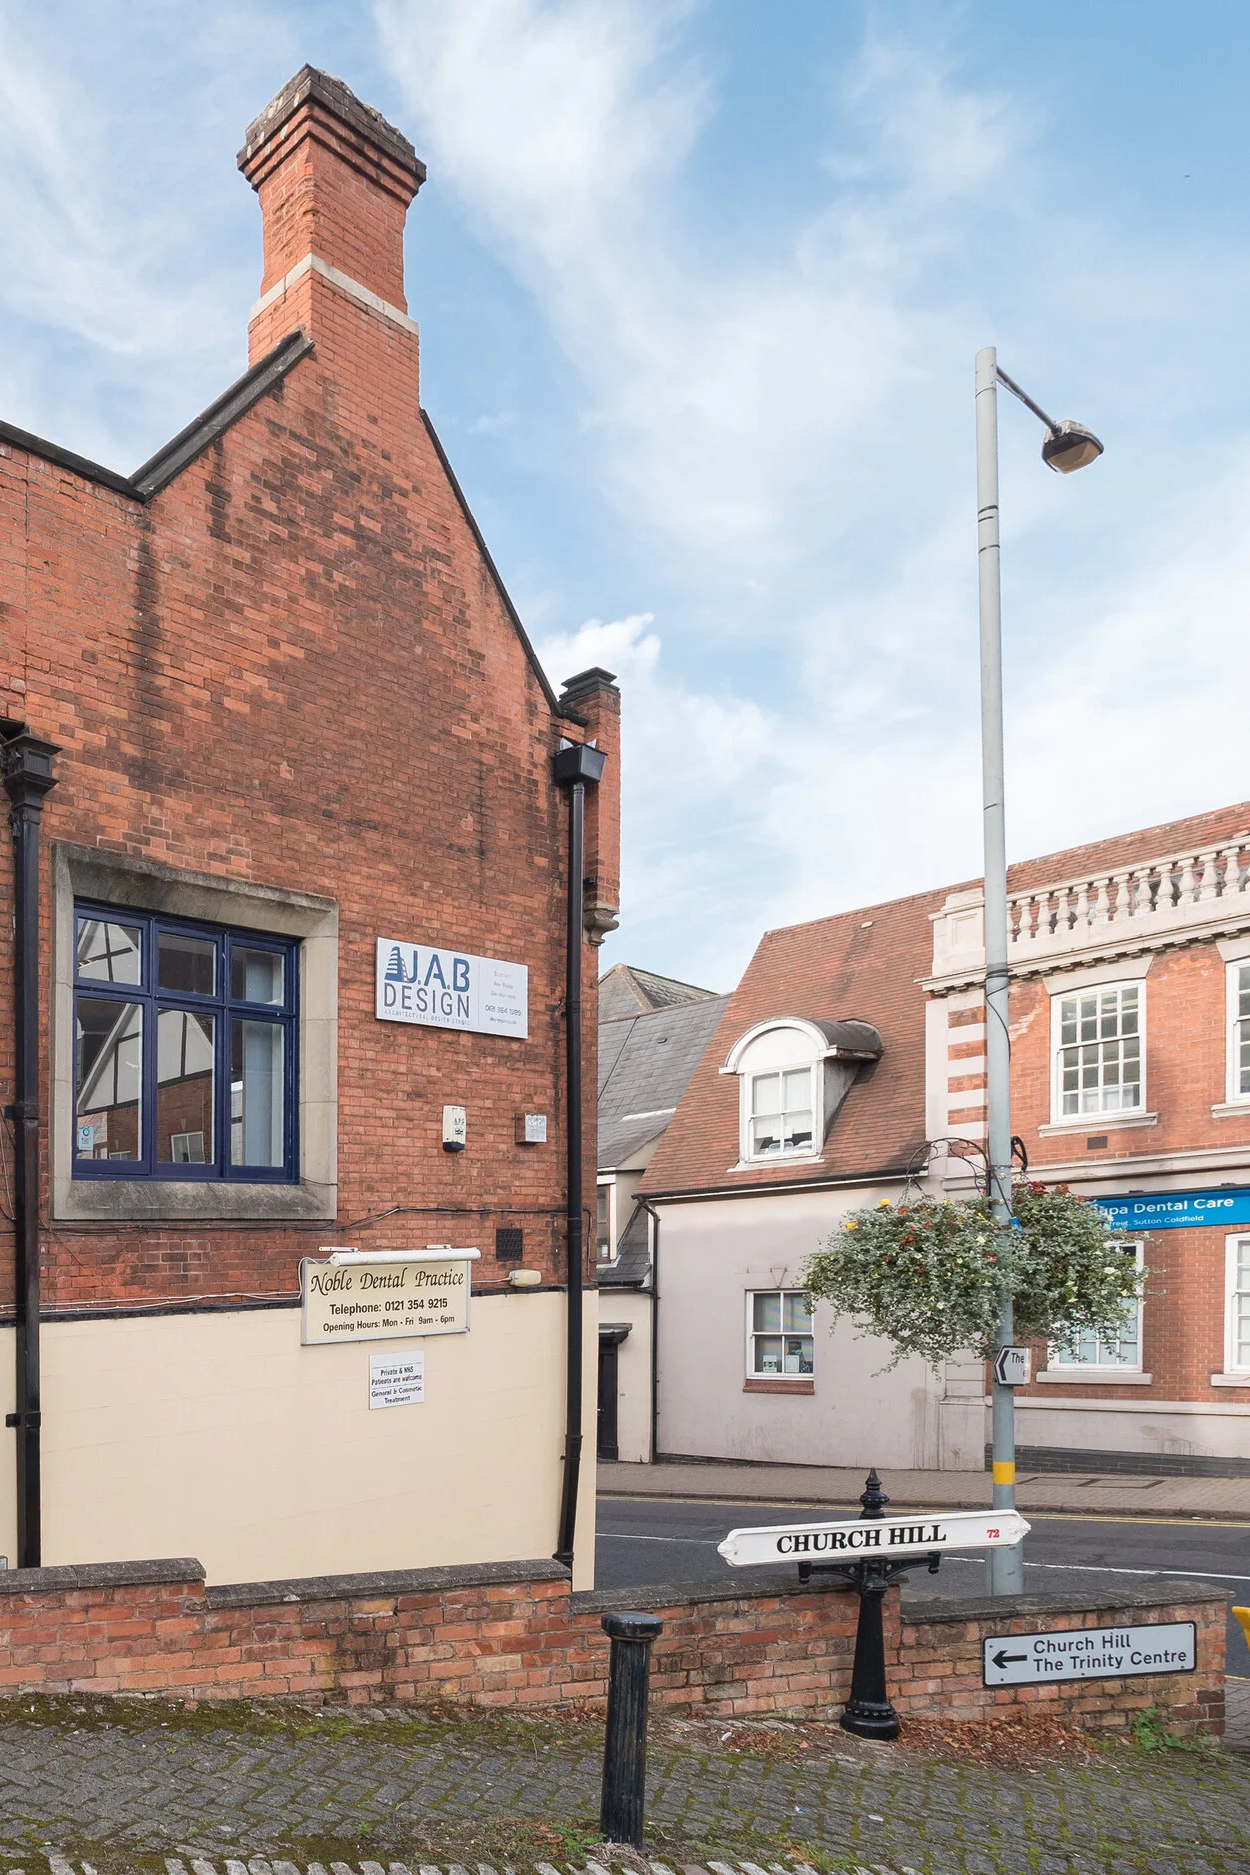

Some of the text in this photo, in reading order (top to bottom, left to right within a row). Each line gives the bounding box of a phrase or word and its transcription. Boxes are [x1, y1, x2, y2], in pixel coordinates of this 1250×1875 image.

[384, 982, 470, 1019] DESIGN
[384, 1009, 429, 1021] ARCHITECTURAL
[431, 1015, 450, 1023] DESIGN
[1134, 1200, 1188, 1214] Dental
[1193, 1198, 1235, 1209] Care
[1133, 1218, 1162, 1226] Sutton
[1164, 1215, 1204, 1223] Coldfield
[310, 1267, 464, 1296] Noble Dental Practice
[330, 1298, 448, 1316] Telephone: 0121 354 9215
[323, 1321, 355, 1333] Opening
[356, 1319, 381, 1330] Hours:
[382, 1319, 398, 1328] Mon
[405, 1317, 414, 1326] Fri
[418, 1316, 433, 1325] 9am
[440, 1315, 455, 1324] 6pm
[1011, 1352, 1025, 1364] The
[372, 1377, 392, 1386] Patients
[402, 1374, 422, 1382] welcome
[381, 1368, 398, 1376] Private
[371, 1389, 392, 1397] General
[398, 1385, 422, 1394] Cosmetic
[384, 1395, 411, 1404] Treatment
[776, 1524, 1000, 1554] CHURCH HILL 72
[1033, 1633, 1132, 1654] Church Hill
[1033, 1649, 1187, 1672] The Trinity Centre
